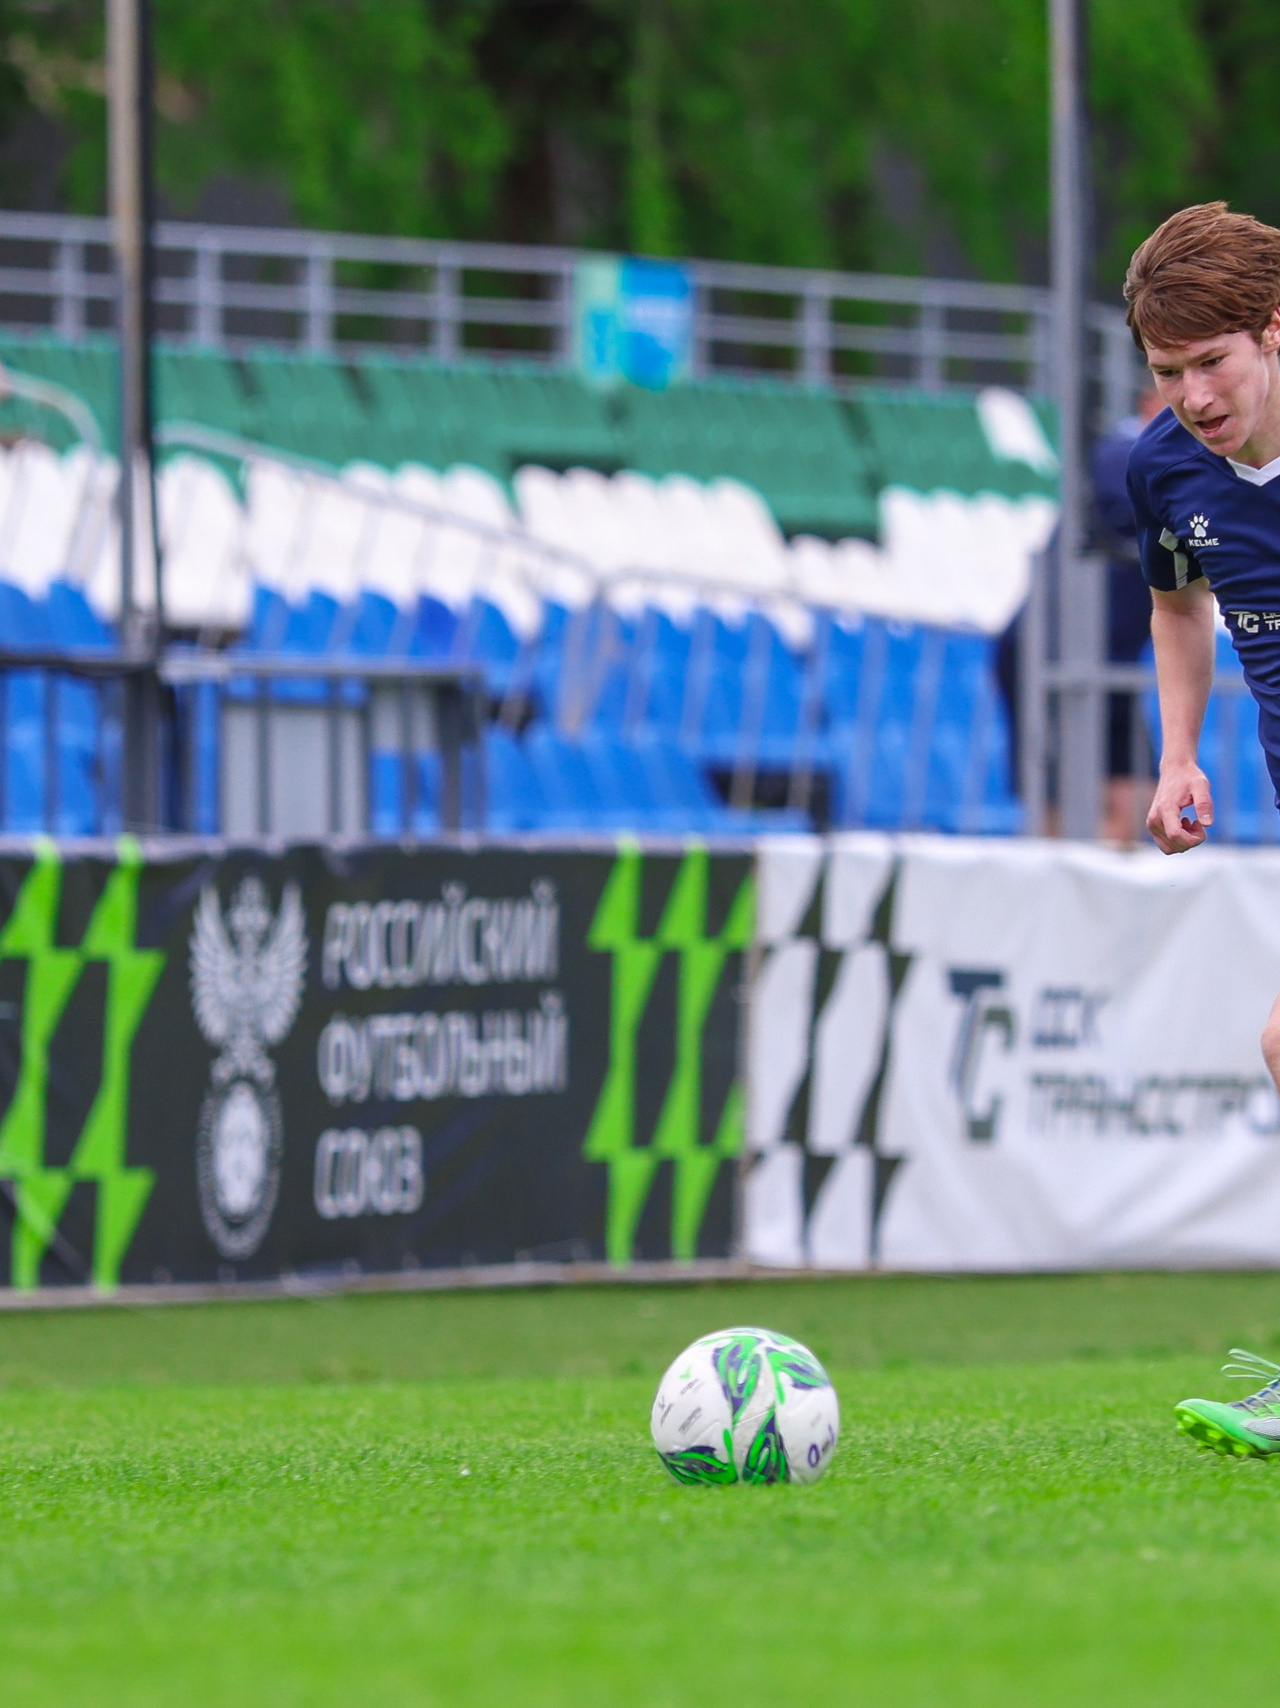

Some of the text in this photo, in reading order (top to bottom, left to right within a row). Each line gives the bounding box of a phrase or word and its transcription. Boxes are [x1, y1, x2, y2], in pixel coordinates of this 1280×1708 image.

[1188, 537, 1220, 547] KELME
[322, 877, 561, 990] РОССИЙСКИЙ
[317, 990, 569, 1106] ФУТБОЛЬНЫЙ
[313, 1126, 424, 1219] СОЮЗ
